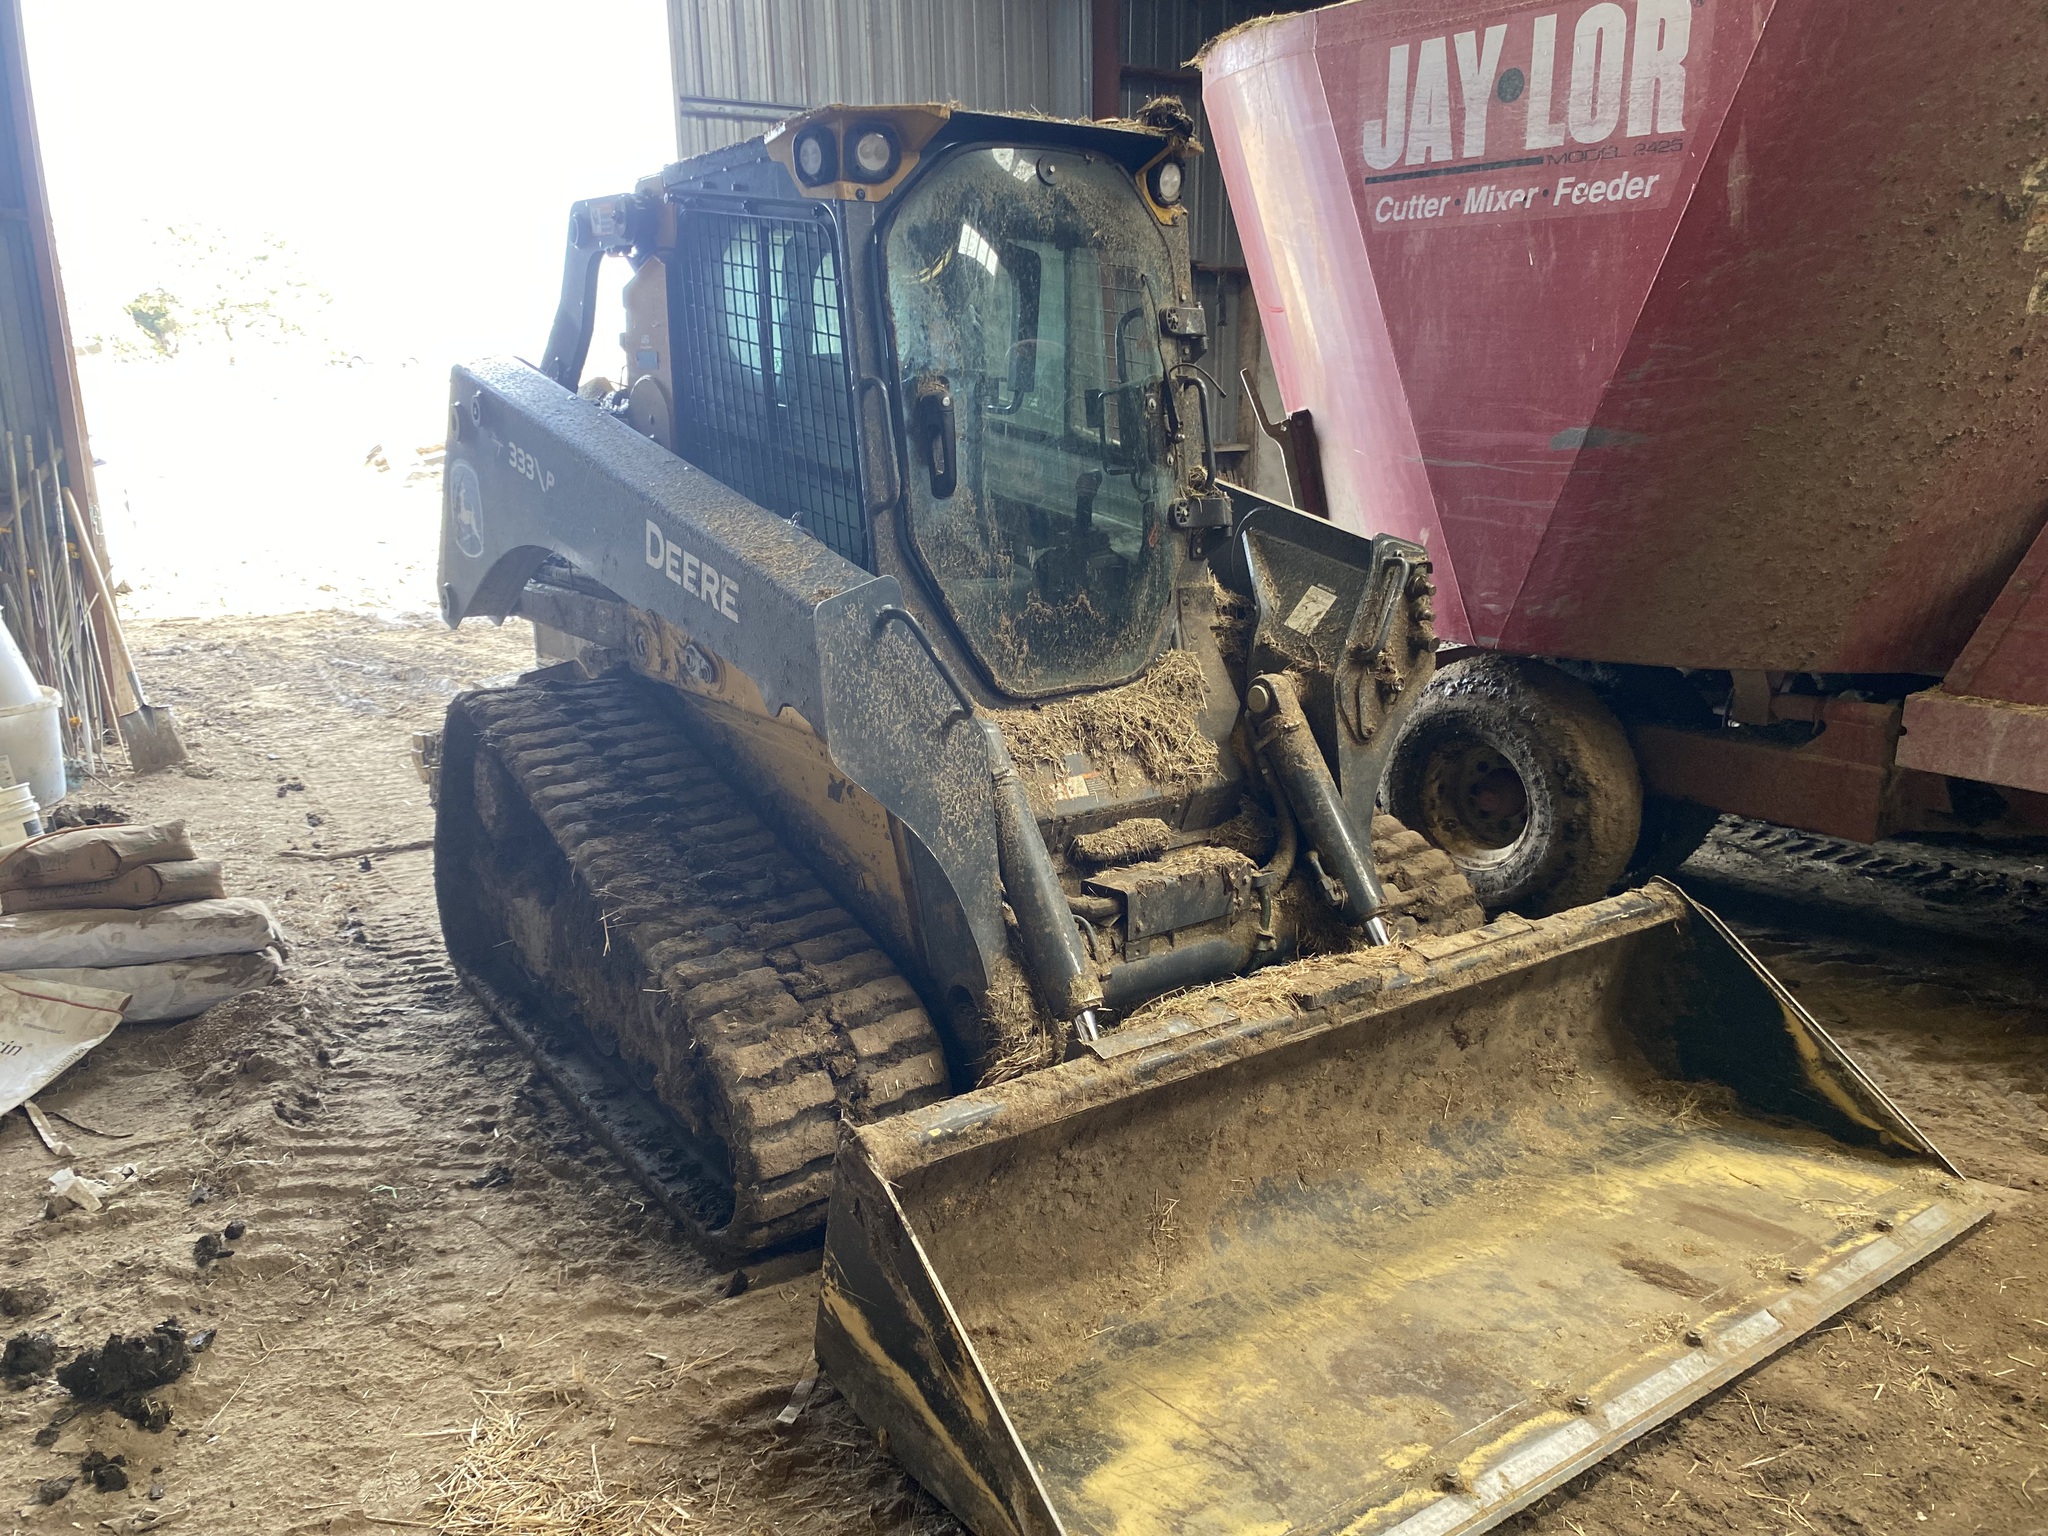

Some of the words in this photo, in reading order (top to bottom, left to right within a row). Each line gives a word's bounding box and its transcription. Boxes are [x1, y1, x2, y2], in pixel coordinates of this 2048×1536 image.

[1548, 146, 1627, 166] MODEL
[1375, 194, 1450, 223] Cutter
[1463, 185, 1539, 214] Mixer
[1553, 171, 1659, 206] Feeder
[646, 518, 739, 624] DEERE
[0, 1040, 23, 1057] in
